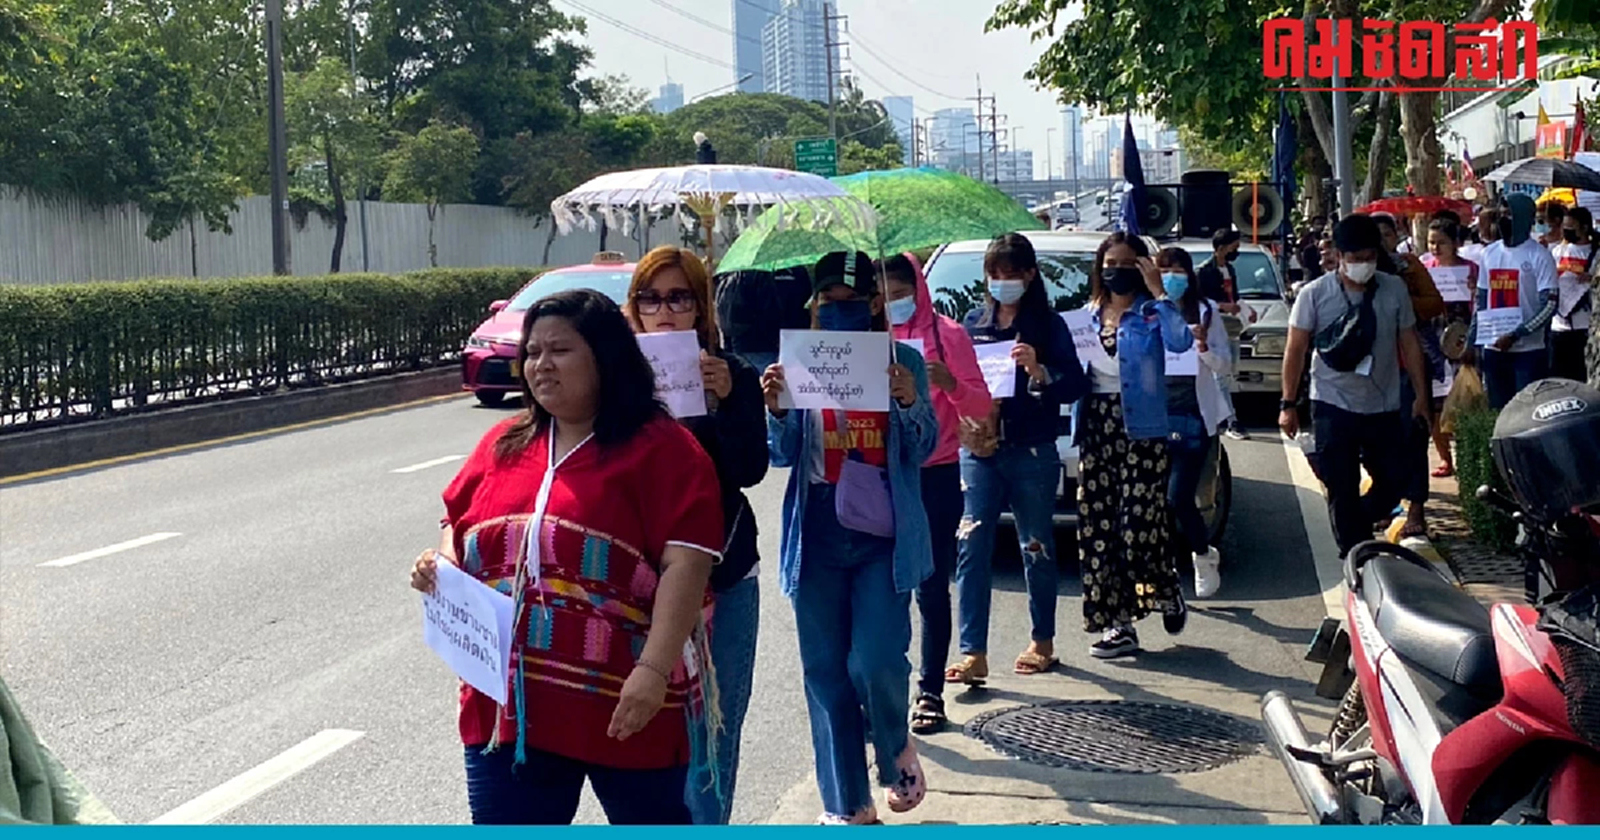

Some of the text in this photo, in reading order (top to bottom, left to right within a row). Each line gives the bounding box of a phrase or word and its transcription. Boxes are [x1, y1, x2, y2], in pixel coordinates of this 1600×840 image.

[1538, 399, 1581, 418] INDEX
[845, 418, 876, 429] 2023
[825, 429, 885, 449] MAY DA
[1495, 711, 1526, 736] HONDA
